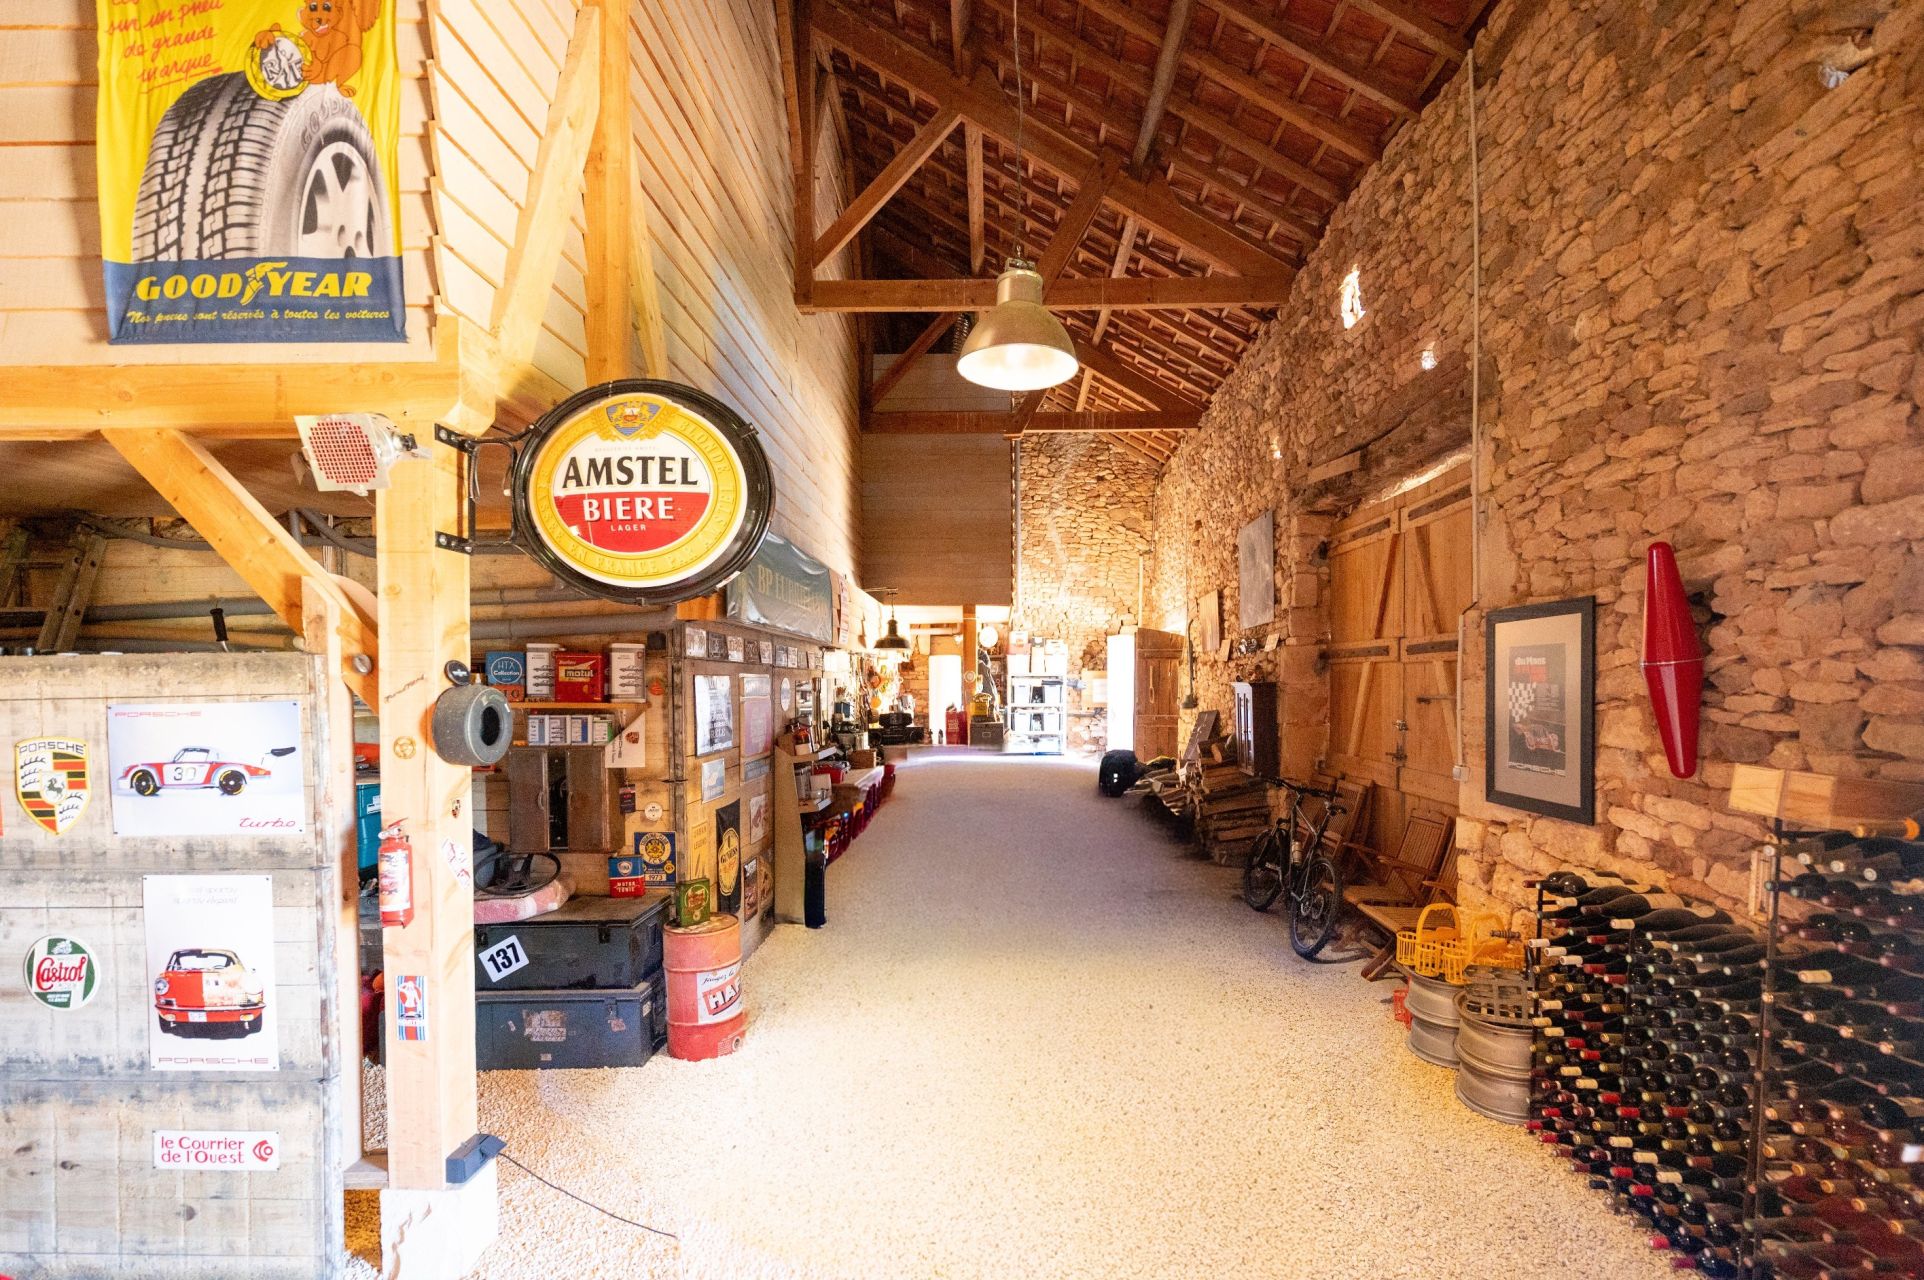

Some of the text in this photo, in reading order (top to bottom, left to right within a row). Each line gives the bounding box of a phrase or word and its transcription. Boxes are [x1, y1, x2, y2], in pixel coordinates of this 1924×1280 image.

[105, 0, 224, 35] sur un pneu
[124, 26, 217, 62] de grande
[137, 53, 218, 81] marque
[126, 310, 151, 323] Nos
[154, 312, 188, 324] pneus
[193, 311, 217, 321] sont
[271, 309, 280, 319] à
[284, 308, 318, 319] toutes
[324, 308, 340, 320] les
[345, 308, 390, 320] voitures
[562, 456, 699, 489] AMSTEL
[583, 497, 674, 522] BIERE
[610, 523, 647, 532] LAGER
[566, 669, 594, 677] motul
[114, 710, 202, 718] PORSCHE
[20, 741, 85, 755] PORSCHE
[239, 816, 297, 829] turbo
[488, 942, 521, 974] 137
[36, 956, 87, 992] Castrol
[158, 1057, 269, 1065] PORSCHE
[161, 1136, 245, 1150] le Courrier
[161, 1150, 245, 1164] de l'Ouest
